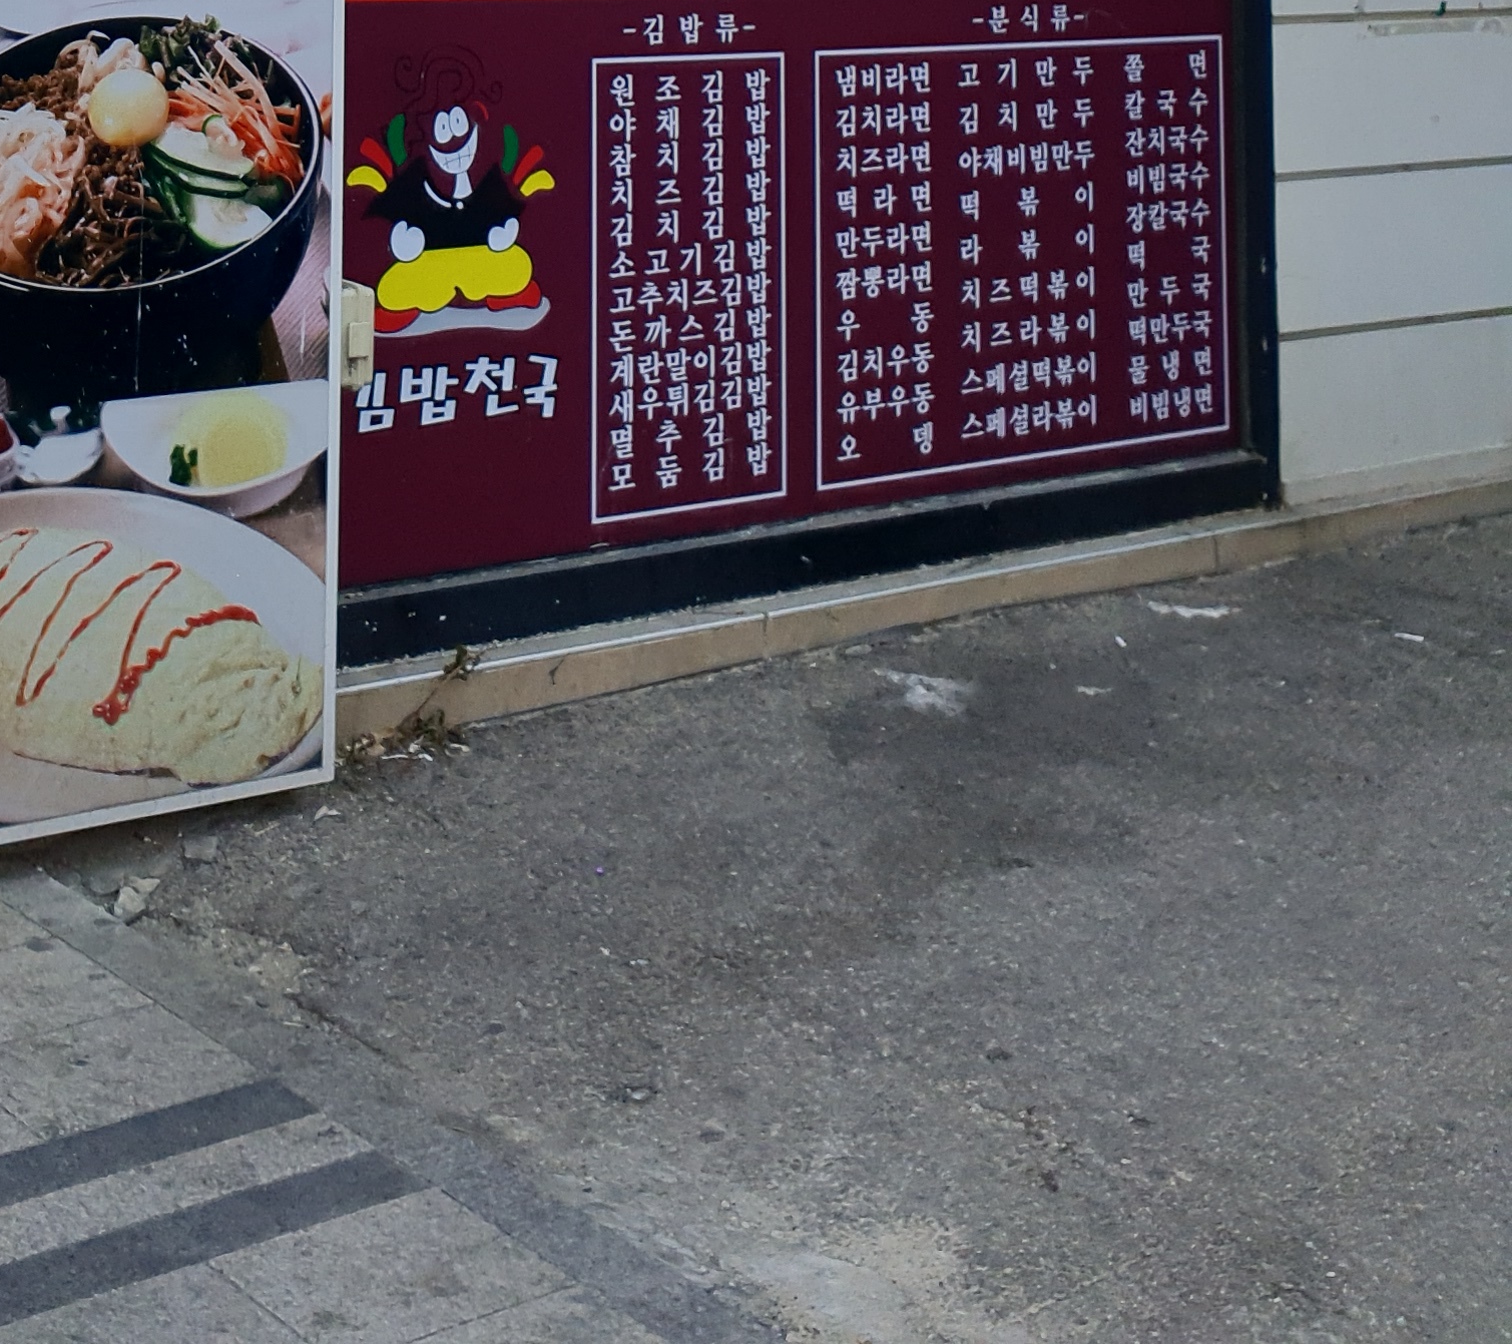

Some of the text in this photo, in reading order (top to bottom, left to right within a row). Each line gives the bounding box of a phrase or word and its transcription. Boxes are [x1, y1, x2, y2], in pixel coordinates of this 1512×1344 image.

[610, 69, 771, 108] 원조김밥
[835, 62, 931, 97] 냄비라면
[958, 55, 1094, 89] 고기만두
[609, 102, 771, 142] 야채김밥
[835, 101, 931, 137] 김치라면
[958, 98, 1094, 136] 김치만두
[1124, 87, 1209, 122] 칼국수
[609, 136, 771, 178] 참치김밥
[835, 140, 932, 178] 치즈라면
[958, 140, 1095, 178] 야채비빔만두
[1125, 124, 1210, 158] 잔치국수
[609, 170, 771, 212] 치즈김밥
[1126, 161, 1211, 196] 비빔국수
[835, 181, 932, 218] 떡라면
[959, 181, 1095, 221] 떡볶이
[1126, 198, 1211, 234] 장칼국수
[609, 203, 771, 247] 김치김밥
[835, 222, 933, 261] 만두라면
[959, 223, 1095, 264] 라볶이
[608, 237, 772, 278] 소고기김밥
[608, 271, 772, 315] 고추치즈김밥
[961, 265, 1096, 309] 치즈떡볶이
[1127, 272, 1212, 309] 만두국
[608, 305, 772, 353] 돈까스김밥
[961, 308, 1096, 353] 치즈라볶이
[1128, 310, 1212, 346] 떡만두국
[608, 339, 772, 388] 계란말이김밥
[837, 341, 935, 384] 김치우동
[960, 351, 1097, 395] 스페셜떡볶이
[1128, 346, 1212, 385] 물냉면
[355, 355, 558, 433] 김밥천국
[608, 373, 772, 423] 새우튀김김밥
[837, 382, 935, 424] 유부우동
[1129, 384, 1214, 423] 비빔냉면
[960, 395, 1097, 440] 스페셜라볶이
[608, 441, 772, 491] 모둠김밥
